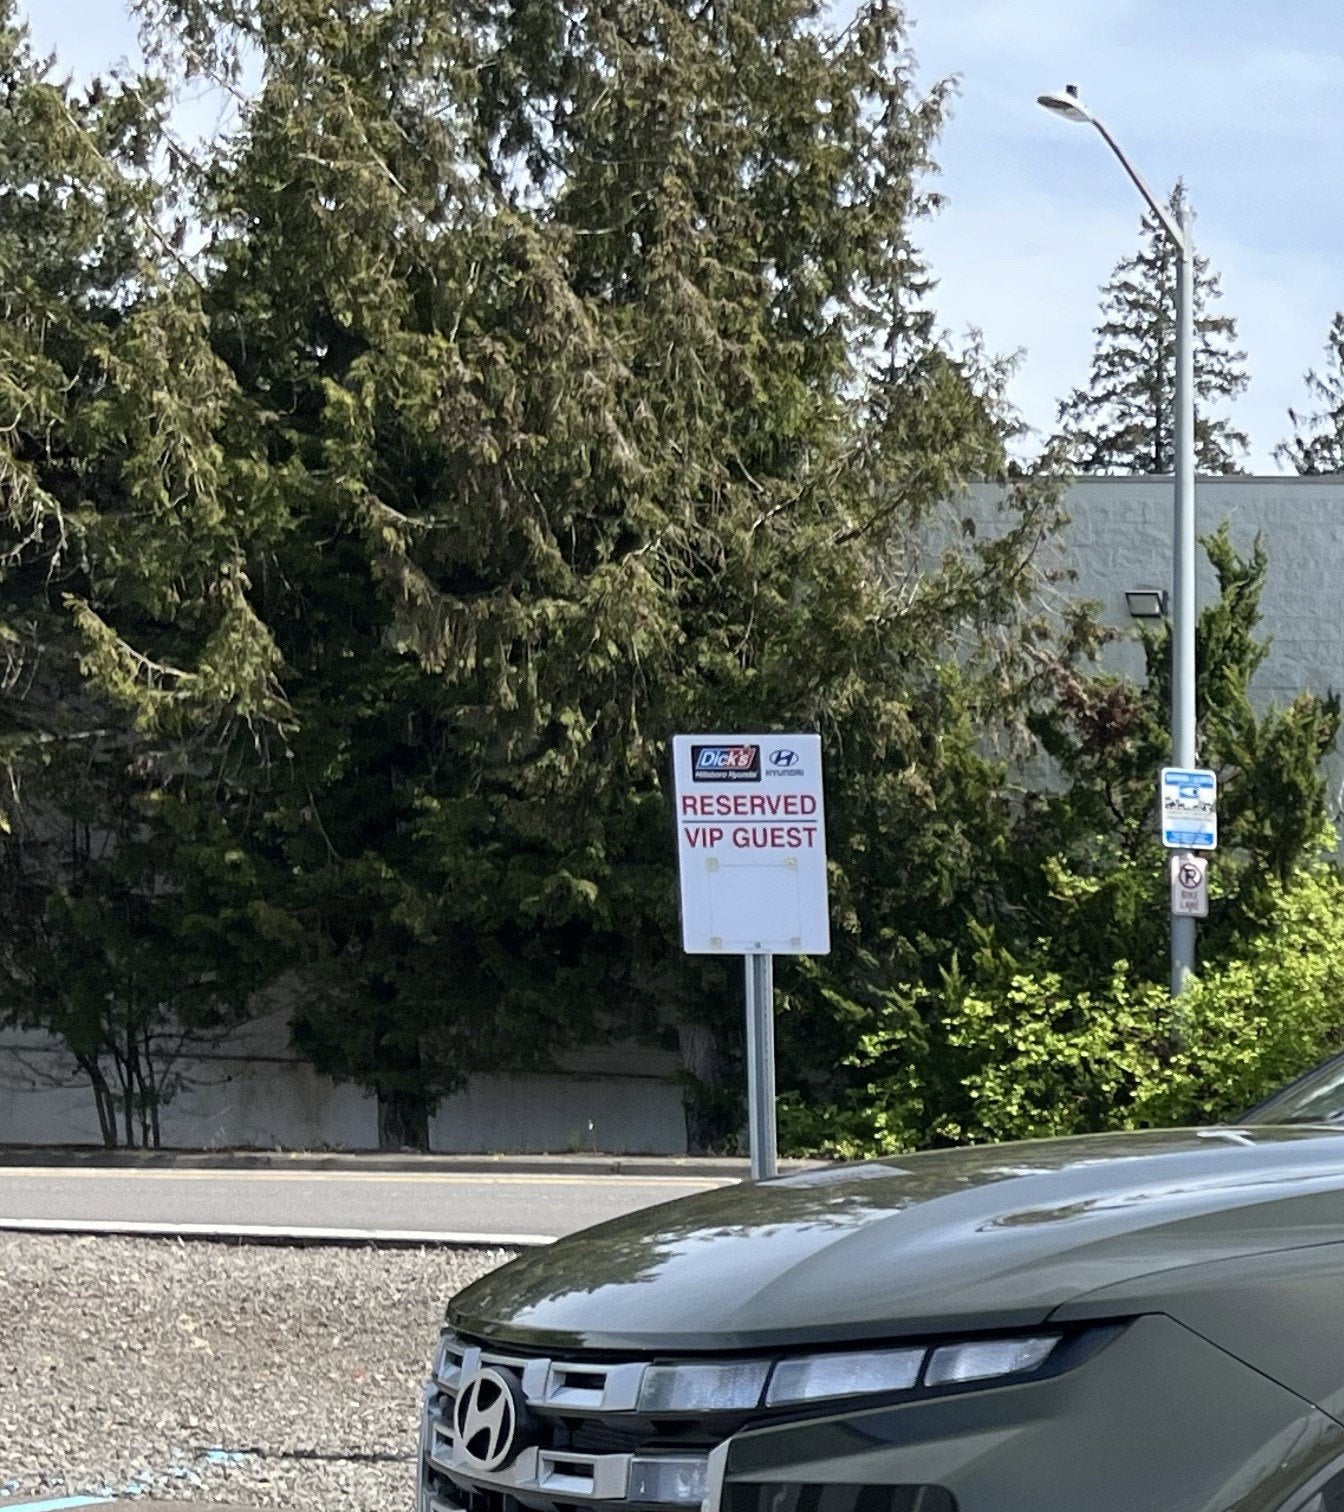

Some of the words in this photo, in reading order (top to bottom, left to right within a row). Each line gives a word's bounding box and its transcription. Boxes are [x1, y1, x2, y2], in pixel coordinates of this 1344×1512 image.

[700, 749, 750, 766] Dick's
[765, 769, 804, 777] HYUNDAI
[682, 794, 817, 815] RESERVED
[684, 828, 724, 848] VIP
[732, 827, 817, 848] GUEST
